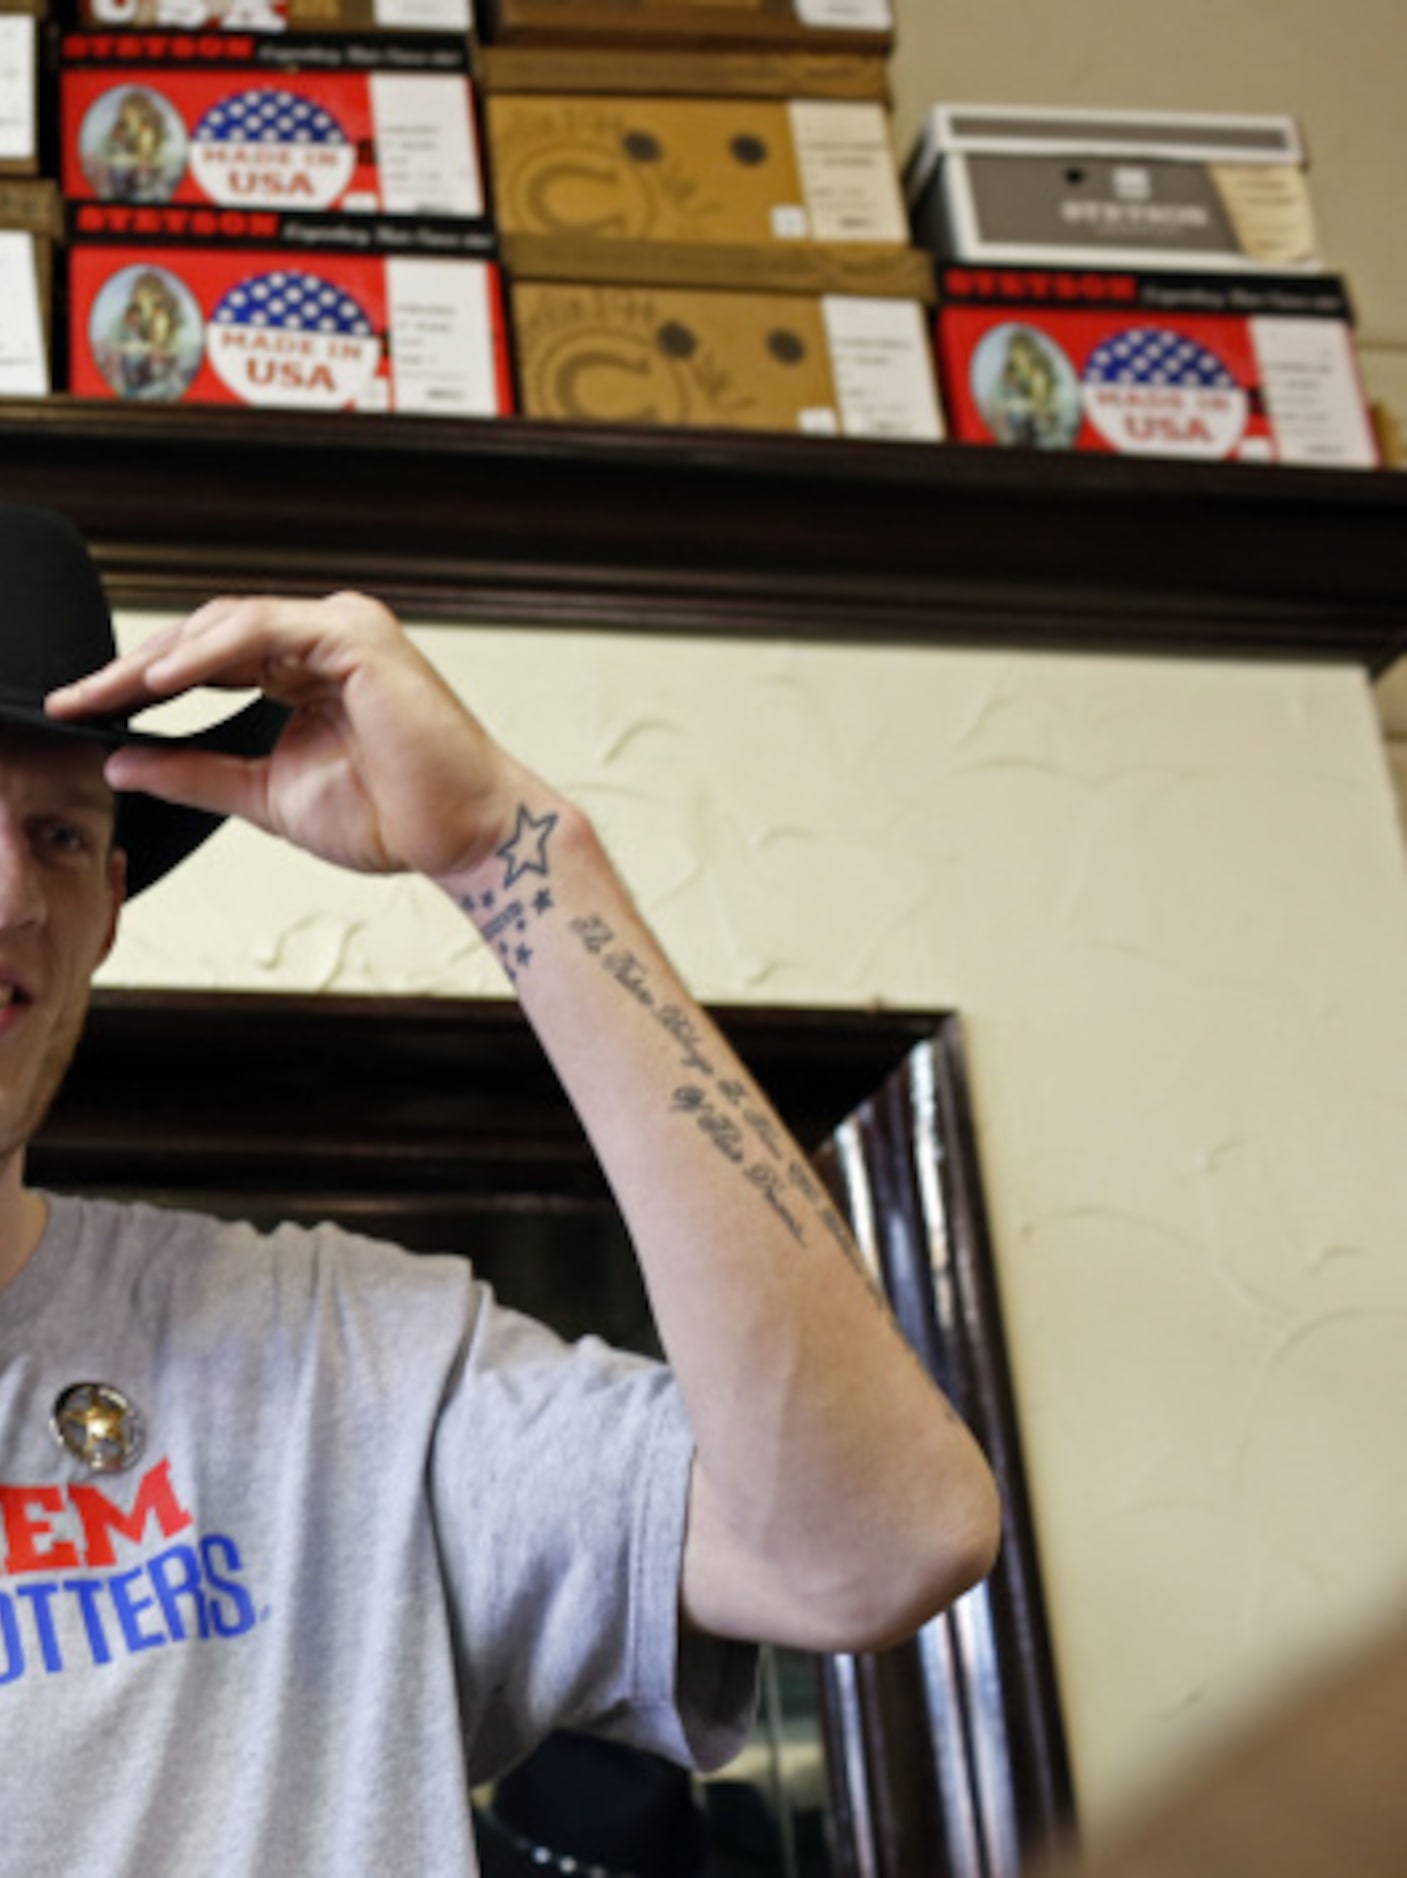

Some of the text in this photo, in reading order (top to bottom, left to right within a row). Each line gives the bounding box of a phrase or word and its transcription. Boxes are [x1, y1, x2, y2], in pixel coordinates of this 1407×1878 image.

[202, 147, 338, 167] MADE IN
[228, 171, 316, 197] USA
[76, 206, 279, 237] STETSON
[221, 329, 363, 361] MADE IN
[246, 359, 337, 392] USA
[1124, 414, 1215, 444] USA
